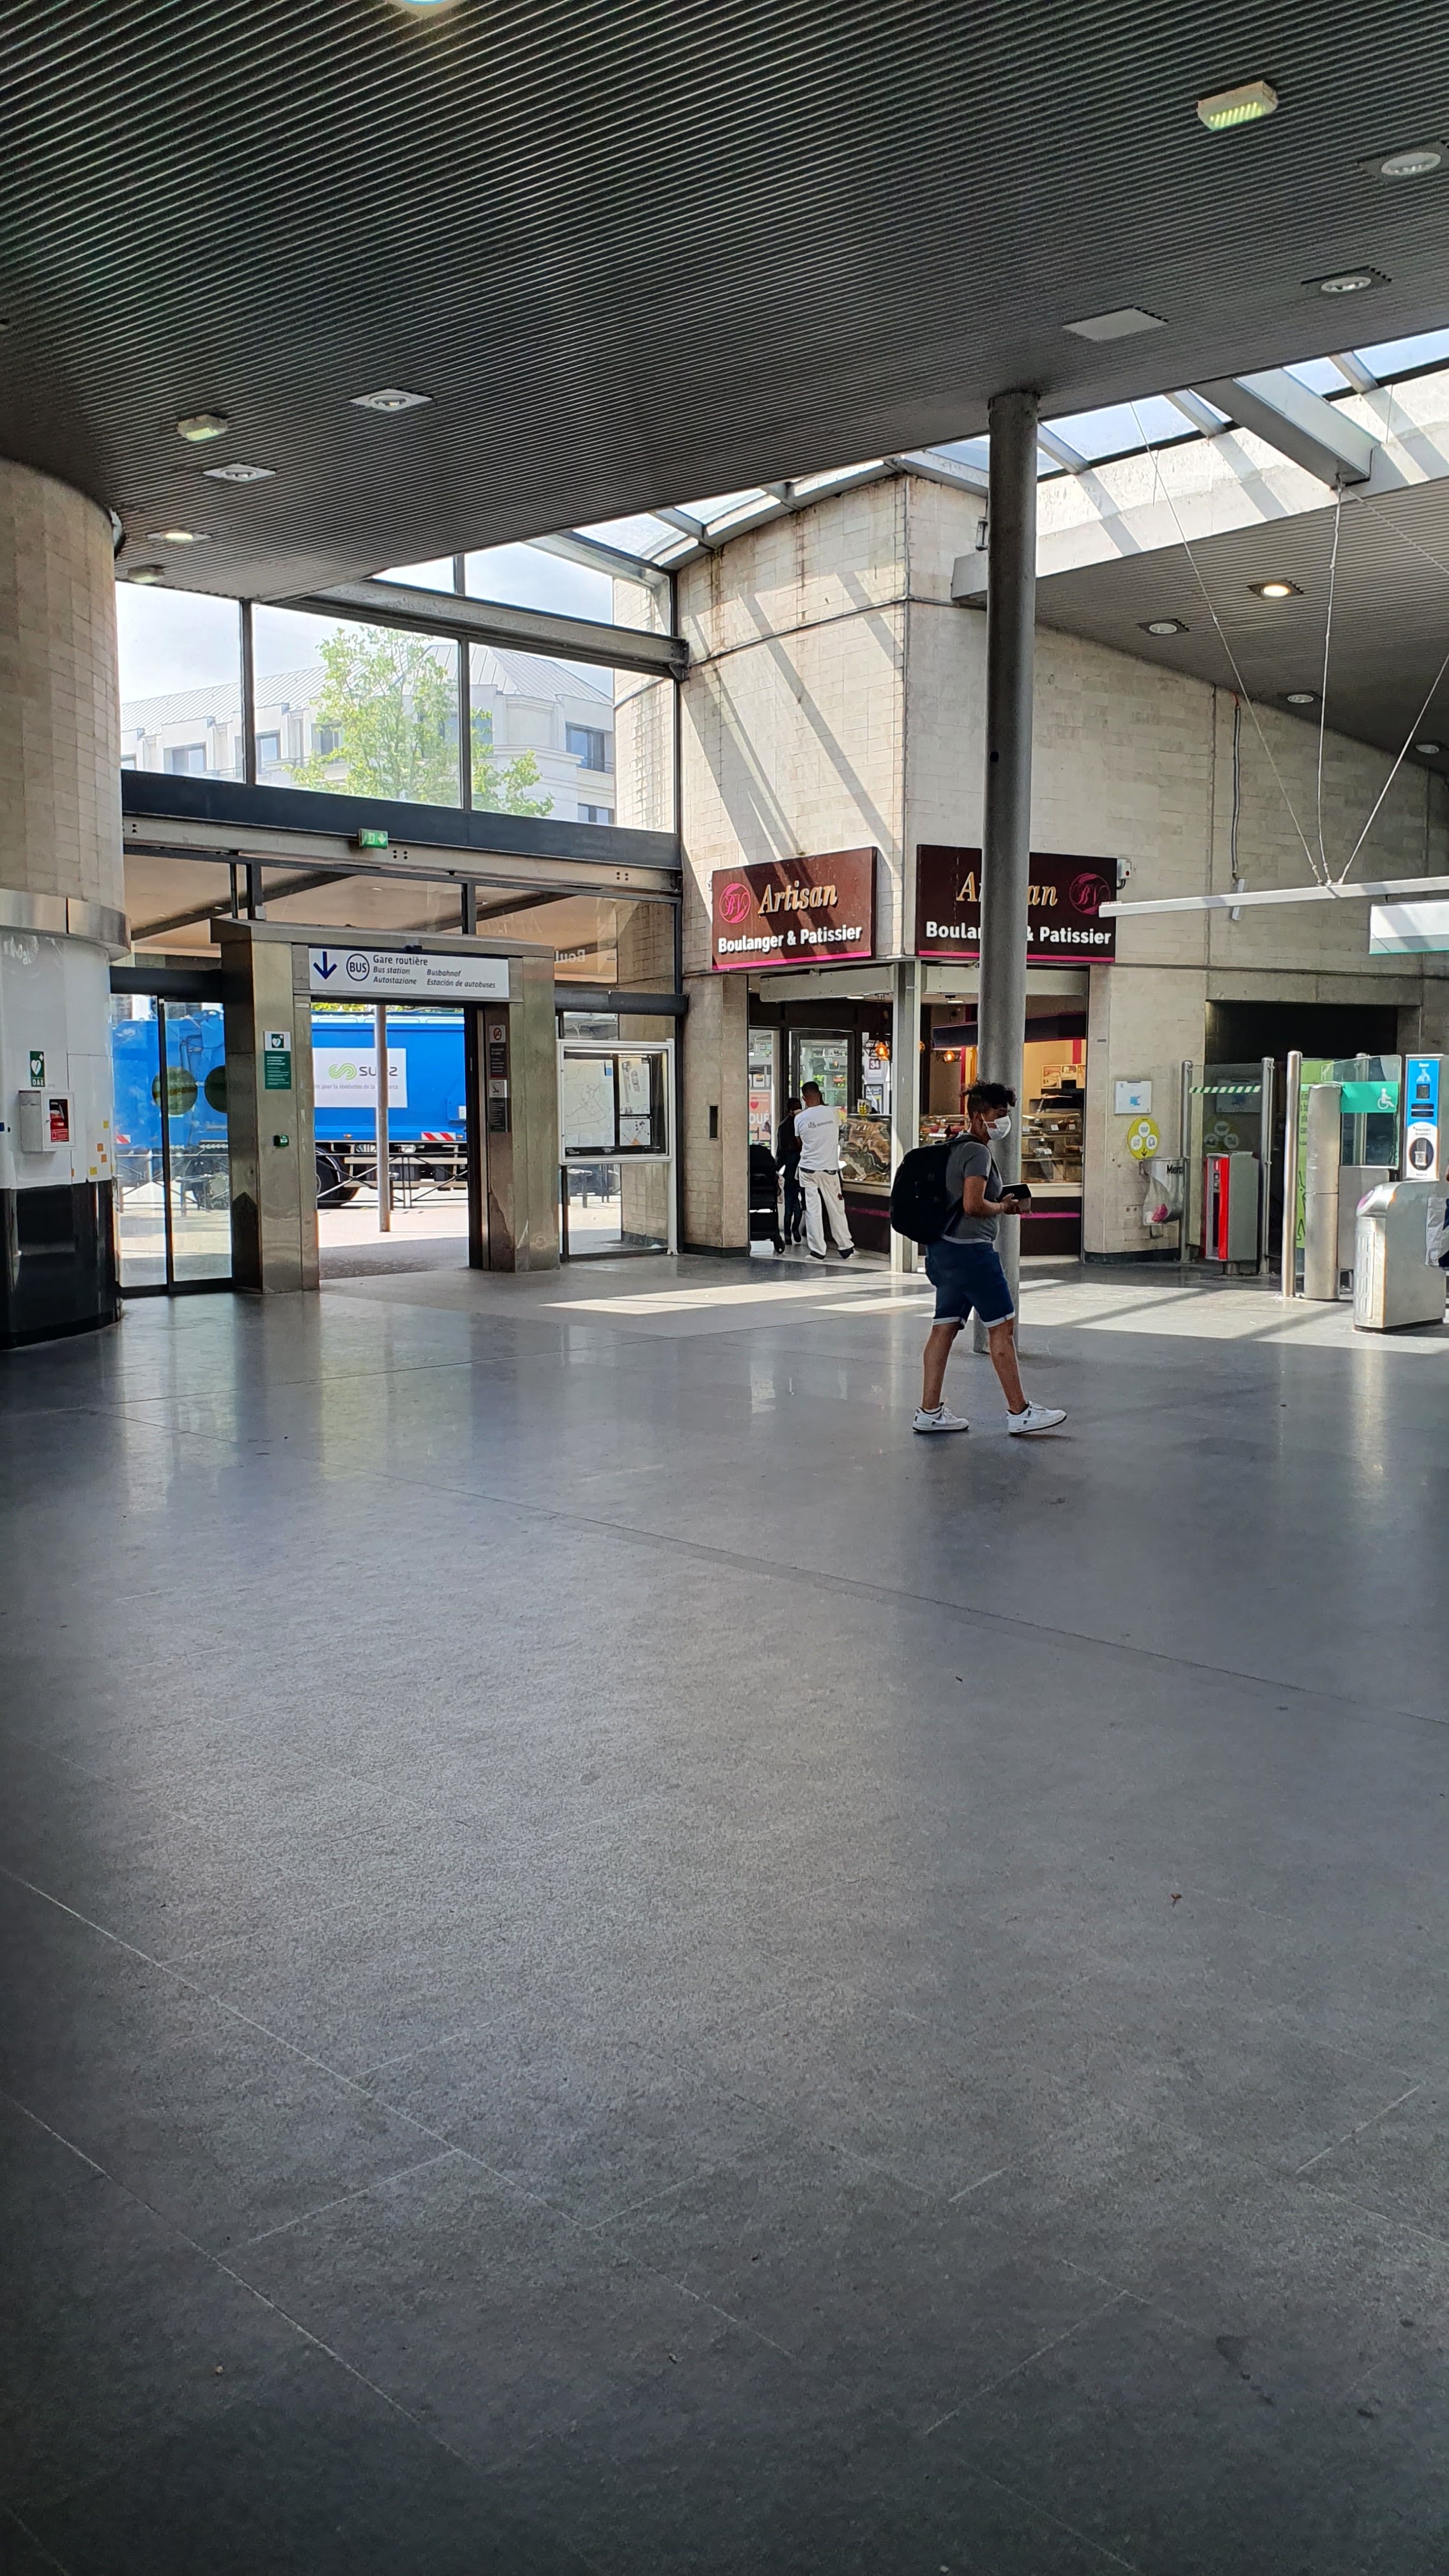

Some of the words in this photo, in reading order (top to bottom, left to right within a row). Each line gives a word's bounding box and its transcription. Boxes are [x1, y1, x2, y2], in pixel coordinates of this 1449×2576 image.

[758, 880, 838, 914] Artisan
[718, 935, 784, 953] Boulanger
[787, 930, 797, 946] &
[800, 924, 862, 945] Patissier
[926, 921, 982, 939] Boula
[1040, 926, 1112, 944] Patissier
[373, 954, 393, 964] Gare
[395, 956, 428, 966] routière
[349, 962, 367, 974] BUS
[373, 976, 417, 985] Autostazione
[426, 978, 454, 987] Estación
[464, 981, 496, 989] autobuses
[870, 1060, 880, 1069] 34
[1167, 1164, 1183, 1174] Merc
